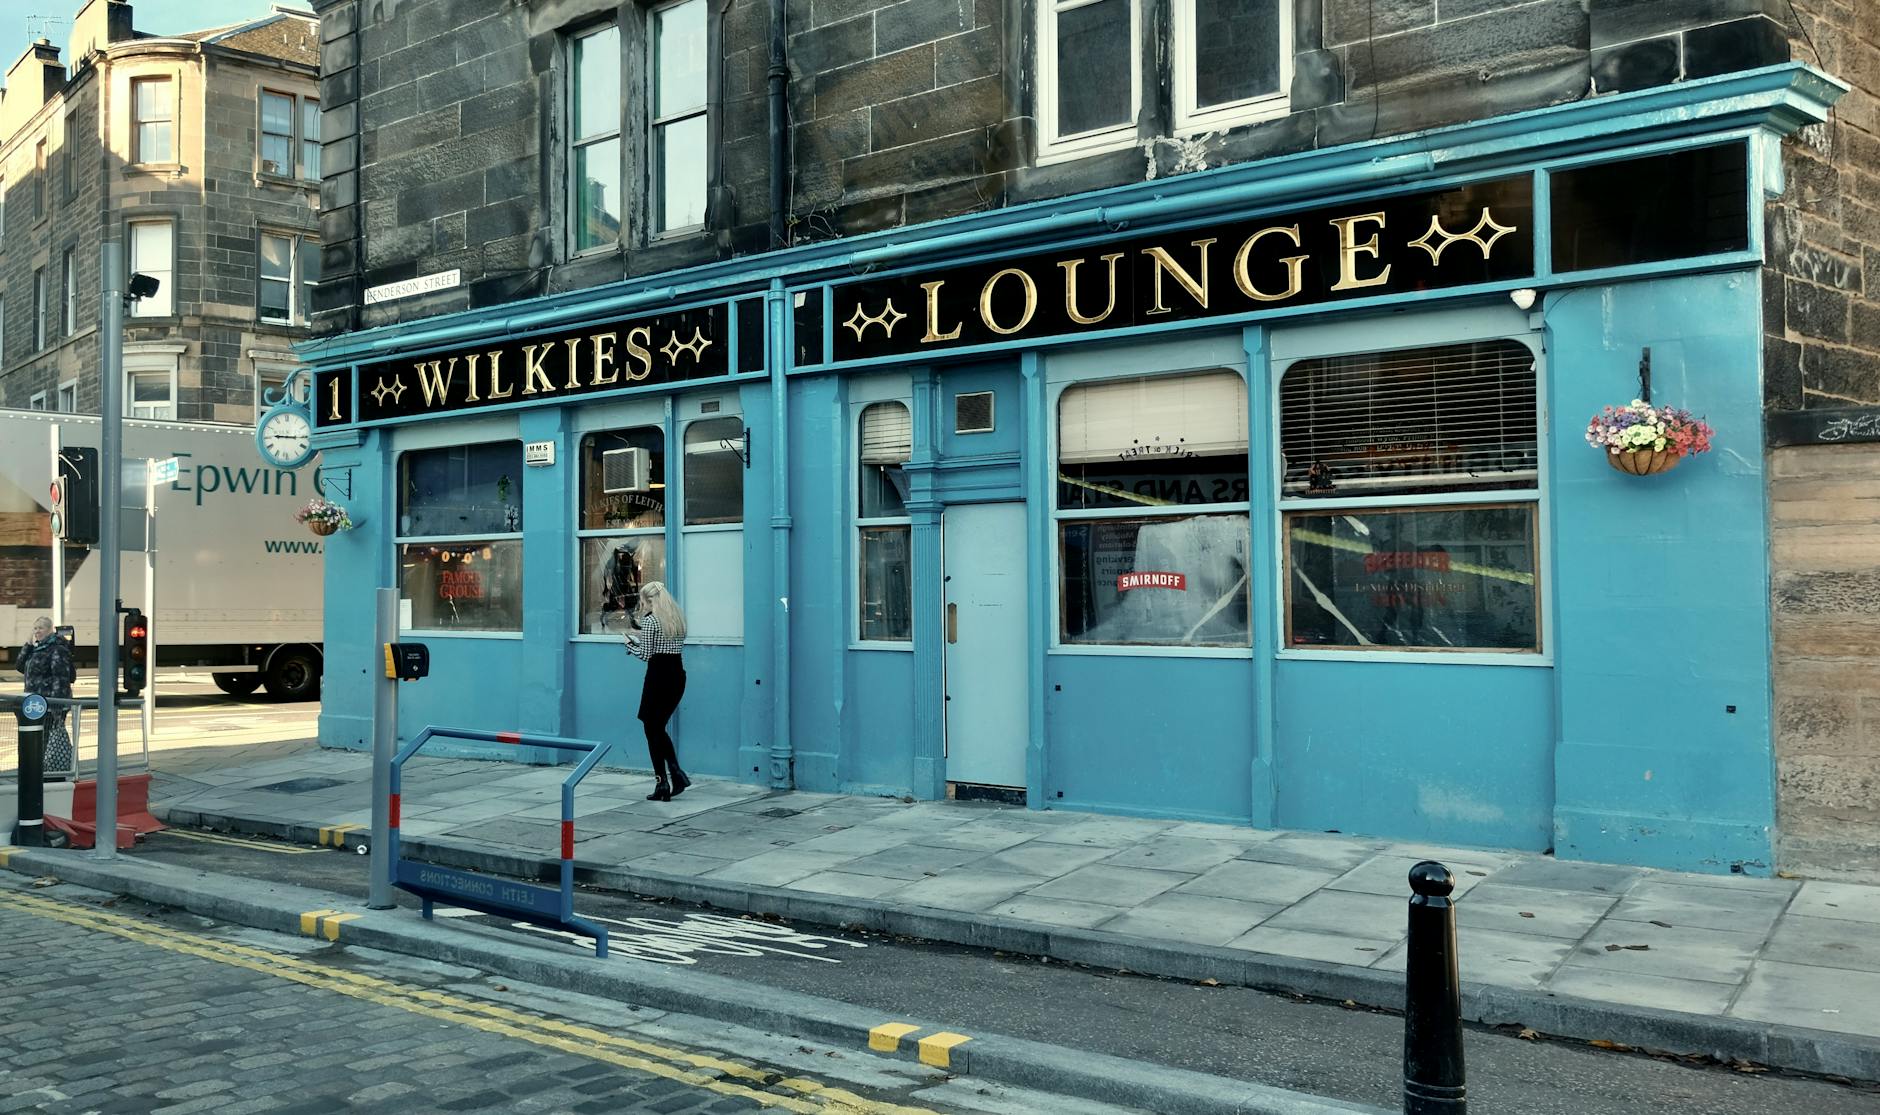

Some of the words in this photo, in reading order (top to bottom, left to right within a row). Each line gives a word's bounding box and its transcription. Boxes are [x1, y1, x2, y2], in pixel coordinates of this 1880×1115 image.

[424, 273, 458, 290] STREET
[920, 211, 1391, 343] LOUNGE
[414, 326, 652, 407] WILKIES
[329, 376, 342, 421] 1
[172, 452, 297, 506] Epwin
[621, 494, 634, 504] OF
[635, 494, 663, 512] LEITH
[1122, 574, 1180, 587] SMIRNOFF
